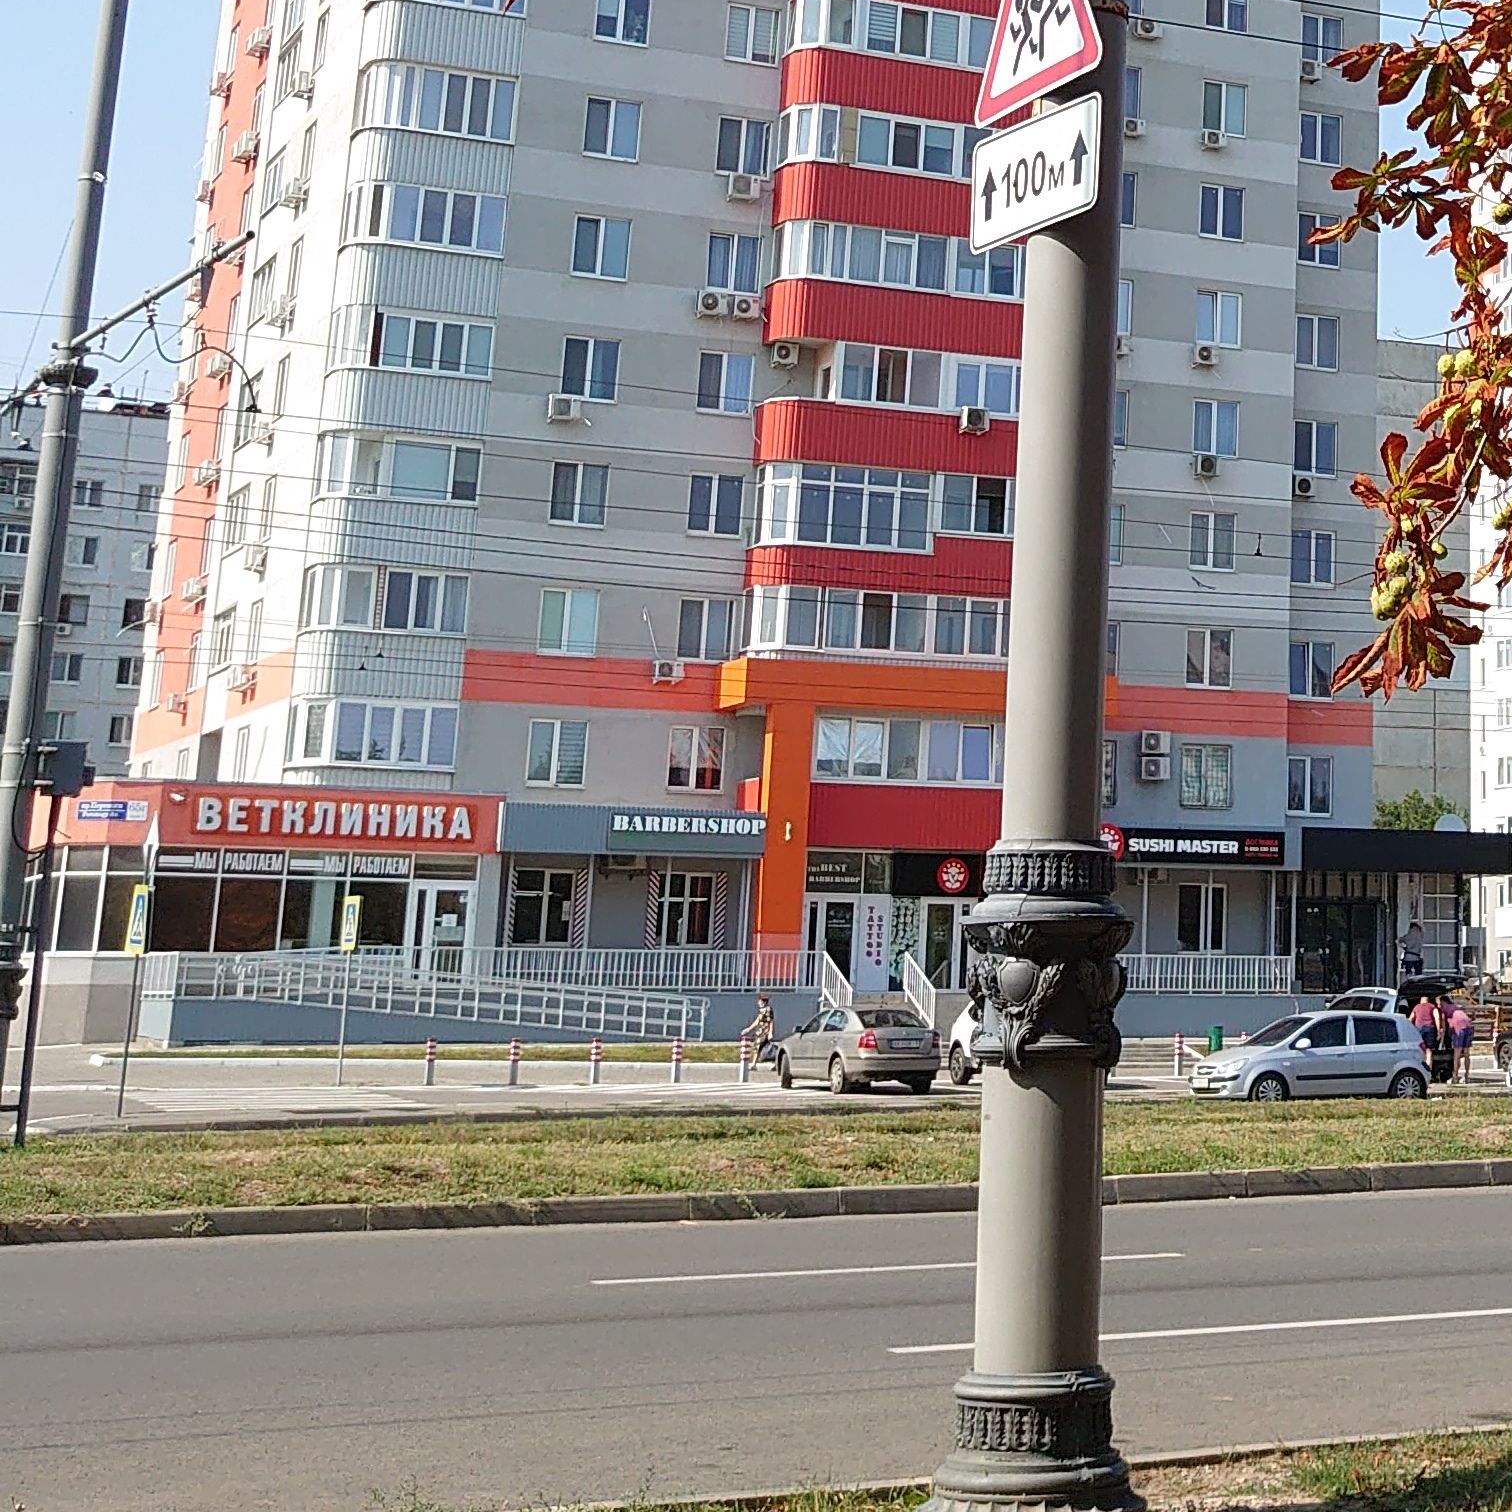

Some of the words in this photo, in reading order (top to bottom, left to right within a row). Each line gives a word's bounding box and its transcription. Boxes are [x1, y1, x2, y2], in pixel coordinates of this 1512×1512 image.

[196, 797, 472, 839] ВЕТКЛИНИКА
[612, 815, 767, 835] BARBERSHOP
[1128, 838, 1174, 853] SUSHI
[1176, 839, 1239, 854] MASTER
[194, 852, 217, 869] МЫ
[225, 853, 283, 872] РАБОТАЕМ
[323, 856, 345, 873] МЫ
[352, 856, 410, 876] РАБОТАЕМ
[820, 863, 848, 873] BEST
[866, 906, 875, 957] TATTOO
[875, 915, 884, 966] STUDIO
